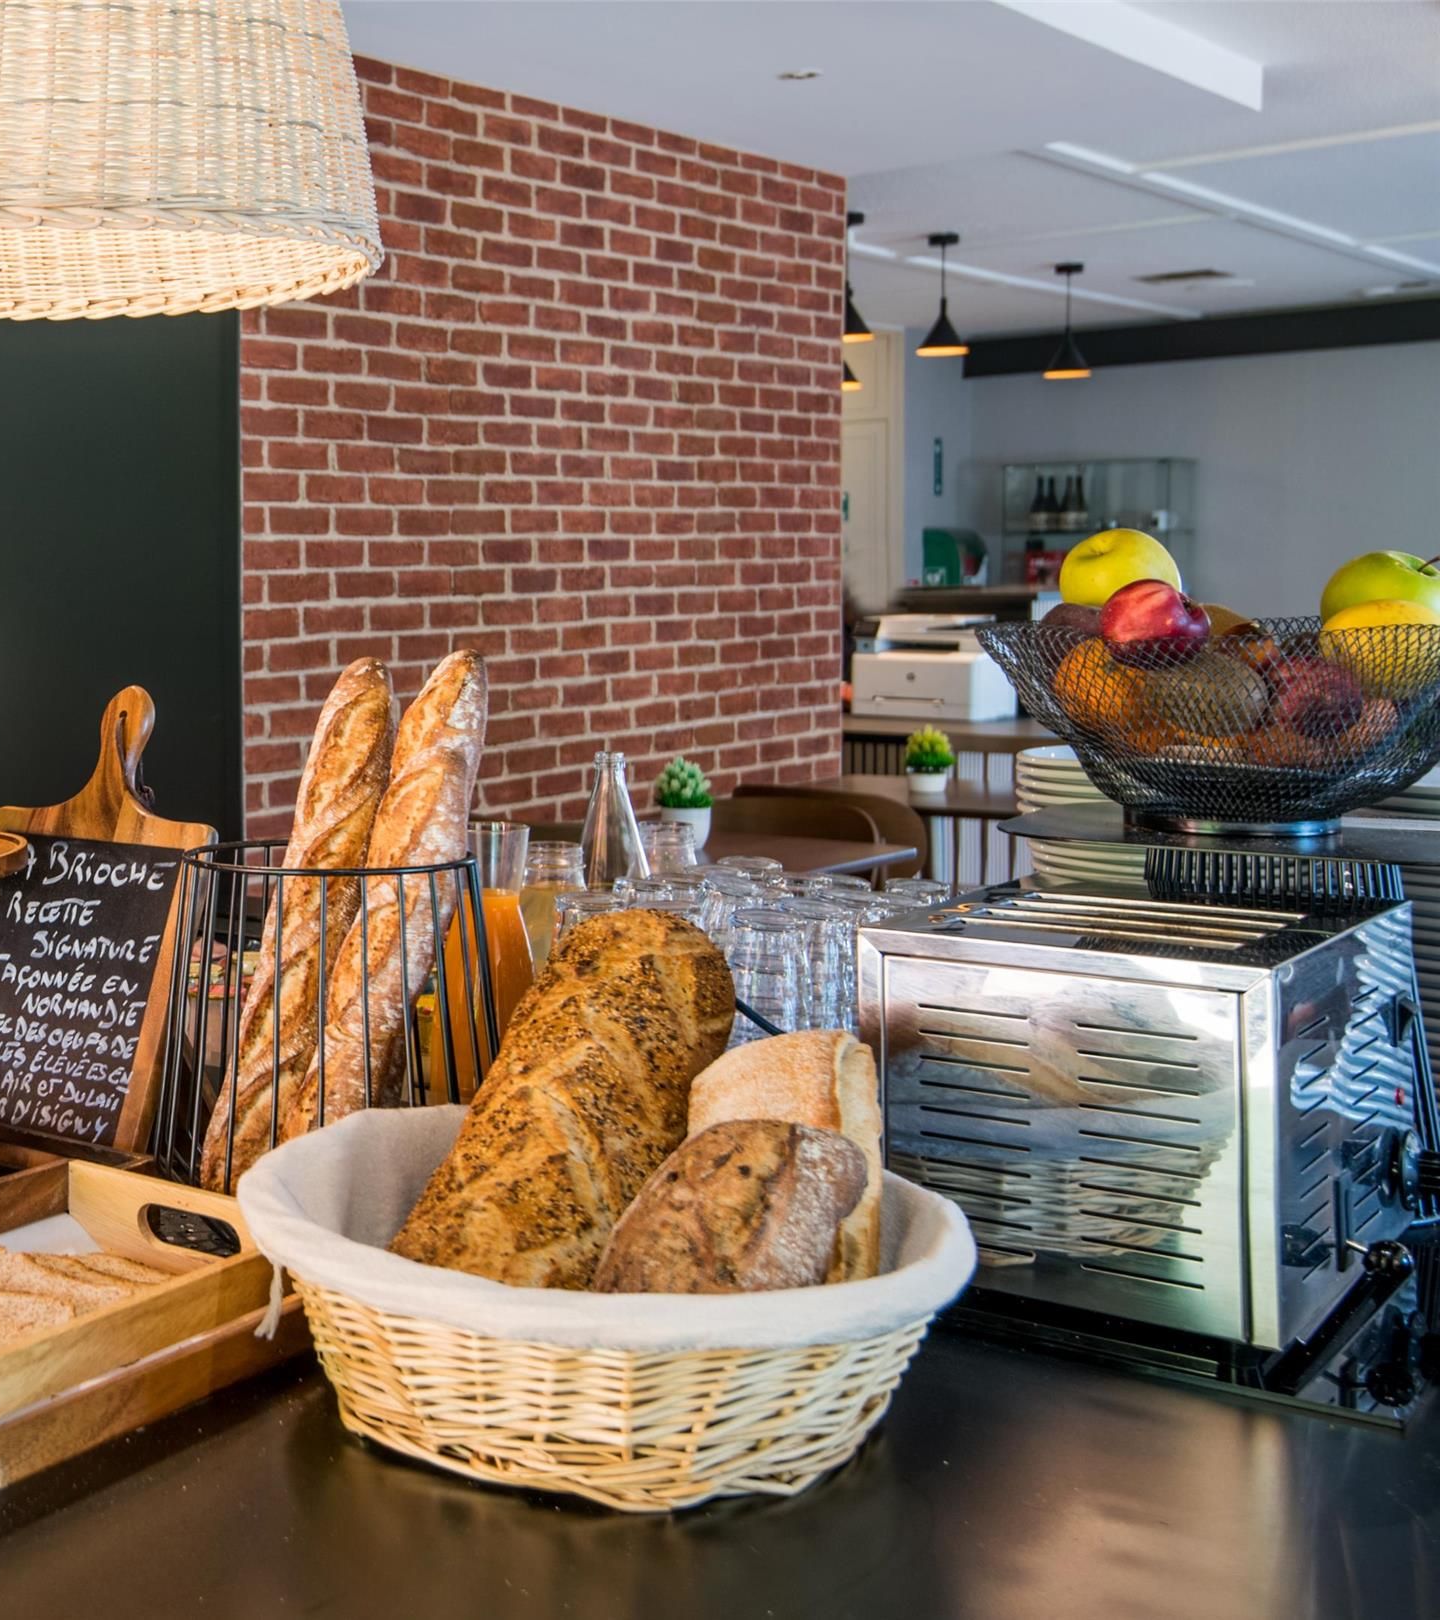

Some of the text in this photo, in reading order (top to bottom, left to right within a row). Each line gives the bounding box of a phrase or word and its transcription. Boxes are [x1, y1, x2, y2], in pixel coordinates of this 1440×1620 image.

[6, 890, 101, 926] RECETTE
[101, 975, 139, 997] EN
[14, 1015, 48, 1042] DES
[111, 1034, 139, 1060] DE
[108, 1066, 134, 1086] EN
